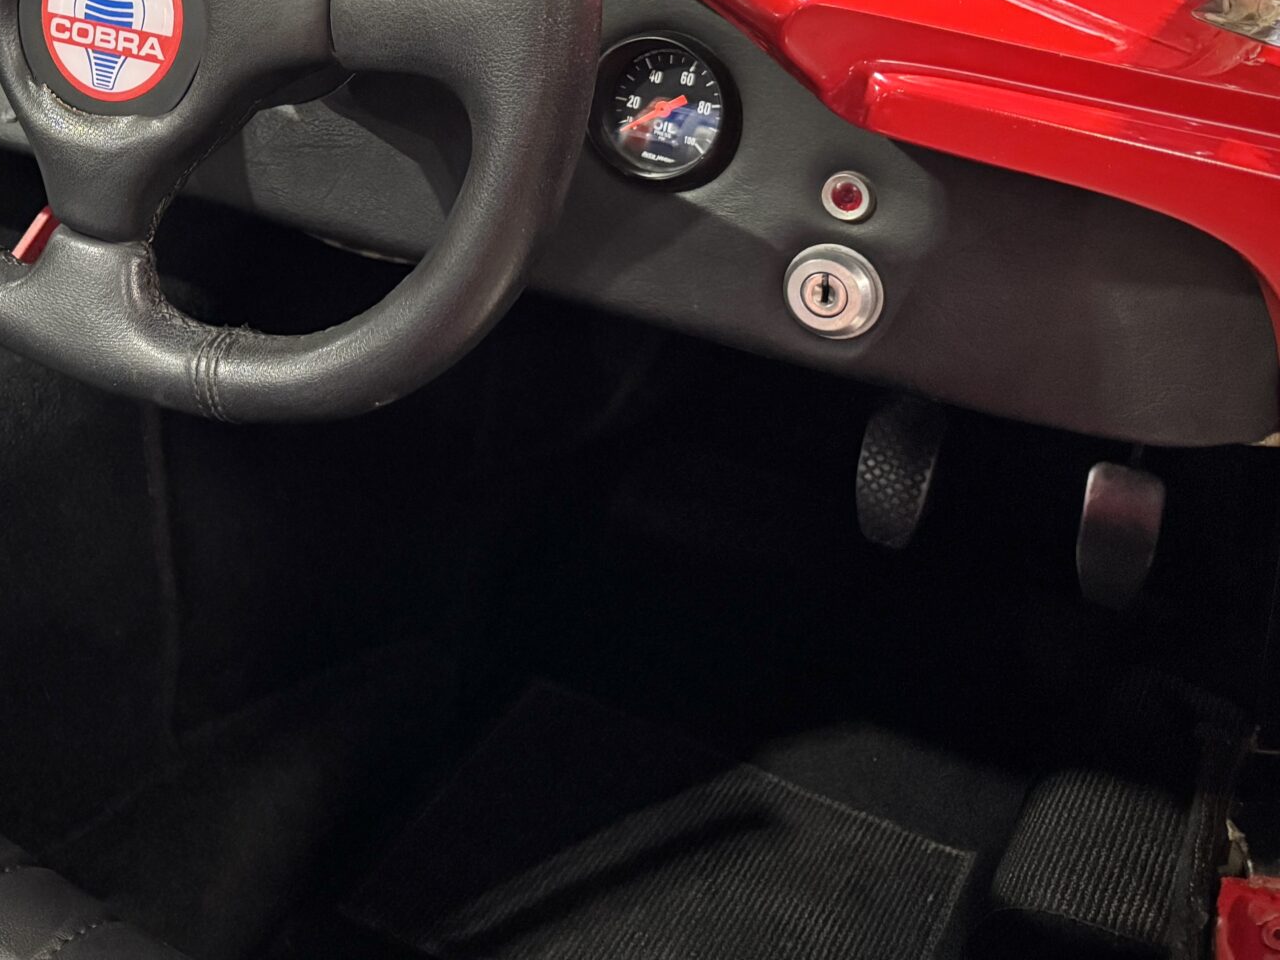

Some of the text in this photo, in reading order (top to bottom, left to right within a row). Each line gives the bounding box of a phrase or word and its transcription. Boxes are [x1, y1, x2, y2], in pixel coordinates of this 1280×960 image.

[50, 17, 165, 61] COBRA
[649, 70, 662, 84] 40
[681, 71, 694, 86] 60
[627, 95, 640, 109] 20
[697, 101, 711, 115] 80
[654, 120, 676, 134] OIL
[685, 136, 696, 146] 100
